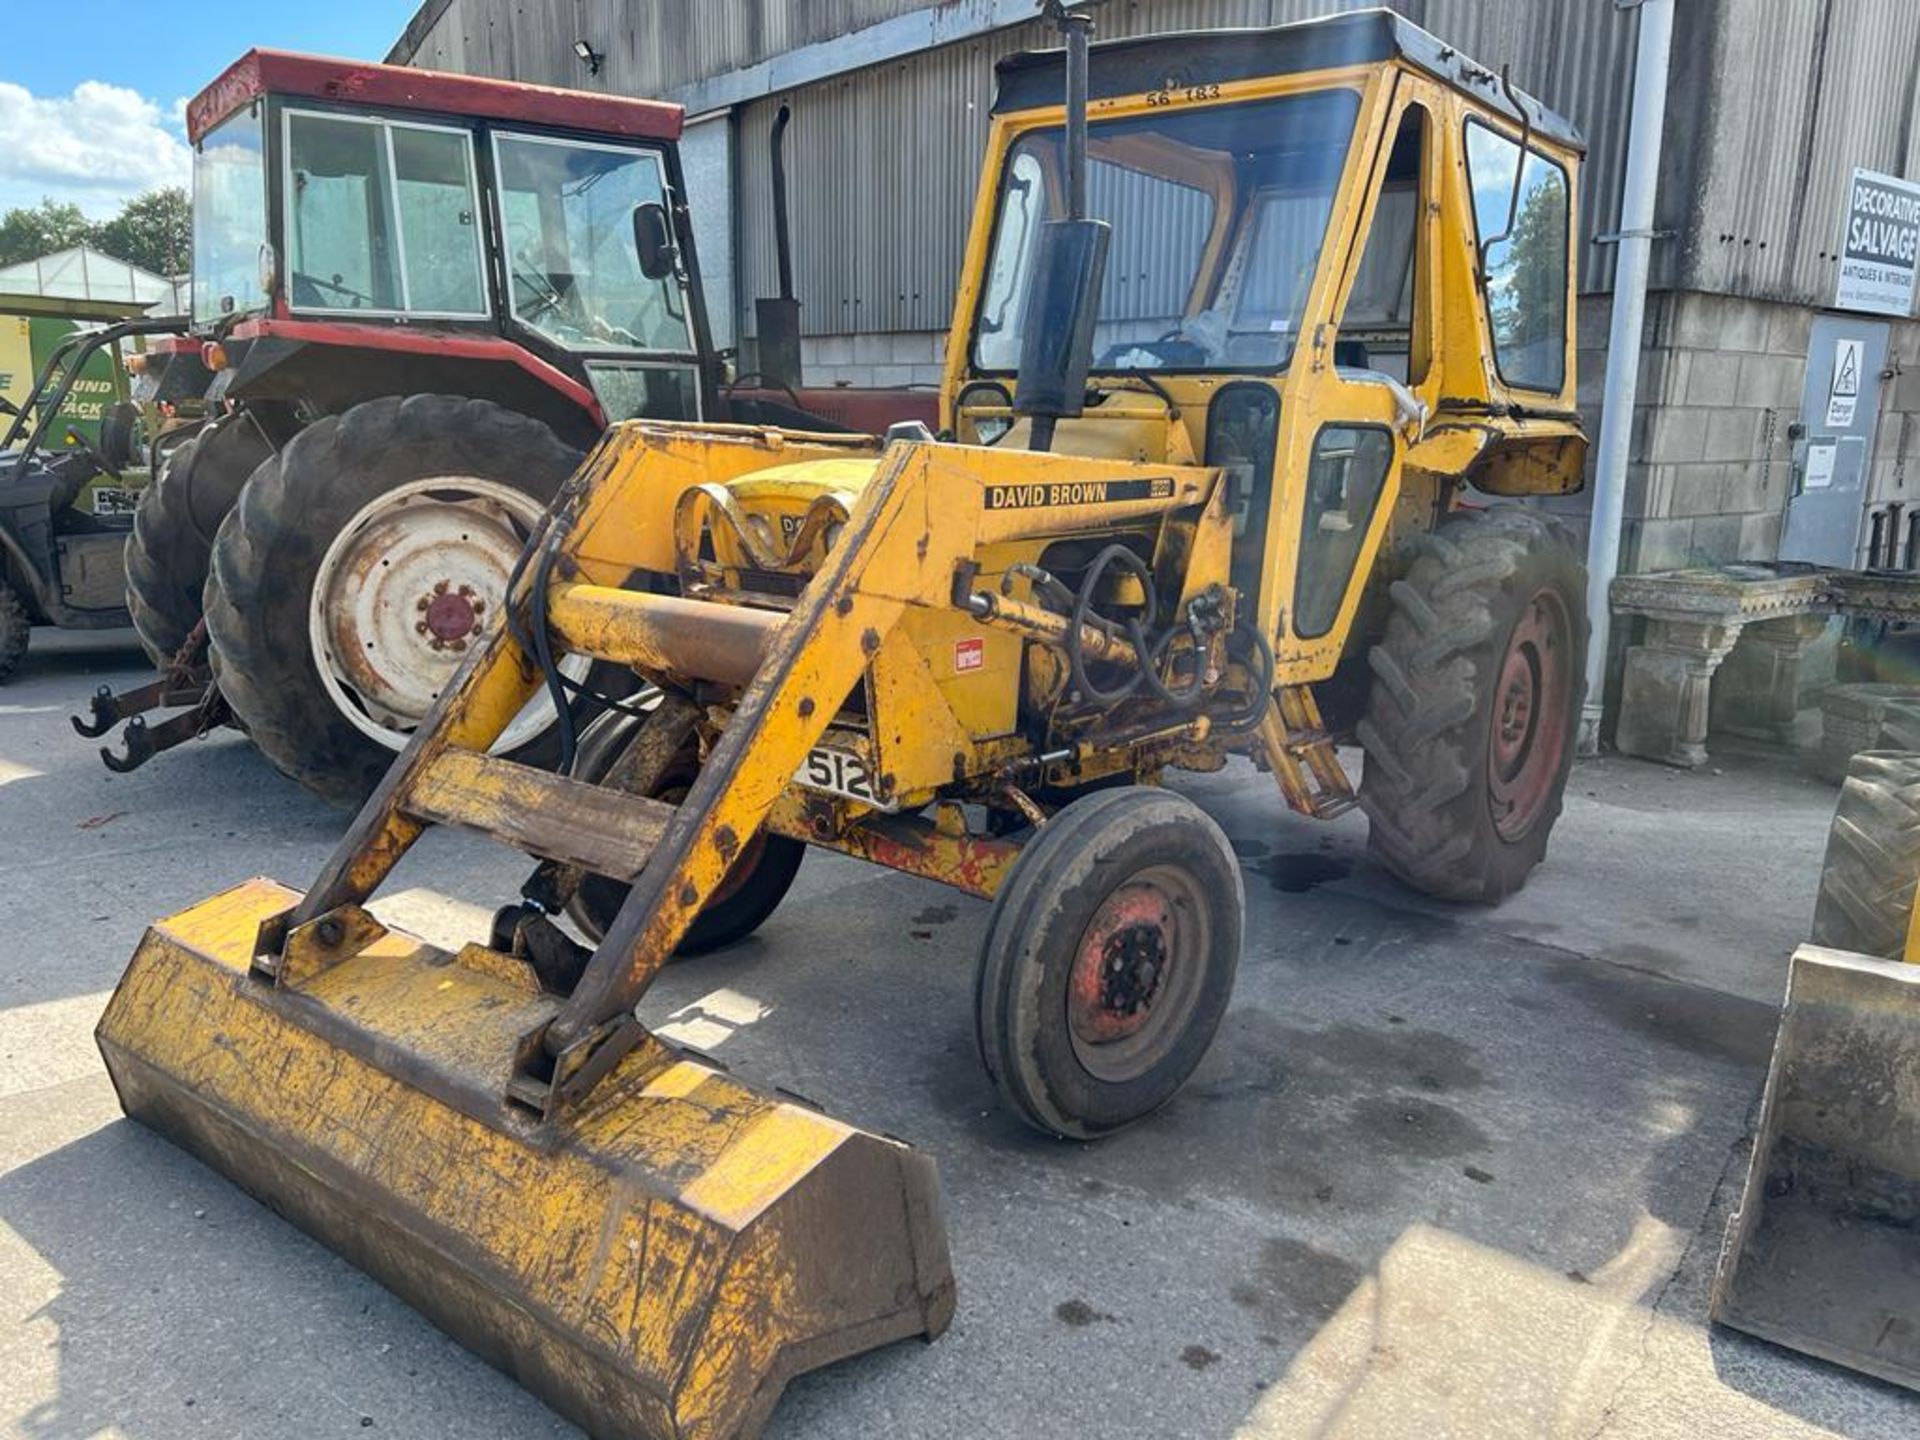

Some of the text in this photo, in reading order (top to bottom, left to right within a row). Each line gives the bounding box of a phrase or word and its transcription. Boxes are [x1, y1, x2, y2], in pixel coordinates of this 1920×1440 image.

[1146, 91, 1171, 107] 56
[1853, 185, 1920, 225] DECORATIVE
[1848, 217, 1918, 261] SALVAGE
[1842, 265, 1877, 282] ANTIQUES
[992, 483, 1107, 508] DAVID BROWN
[808, 749, 890, 806] 512
